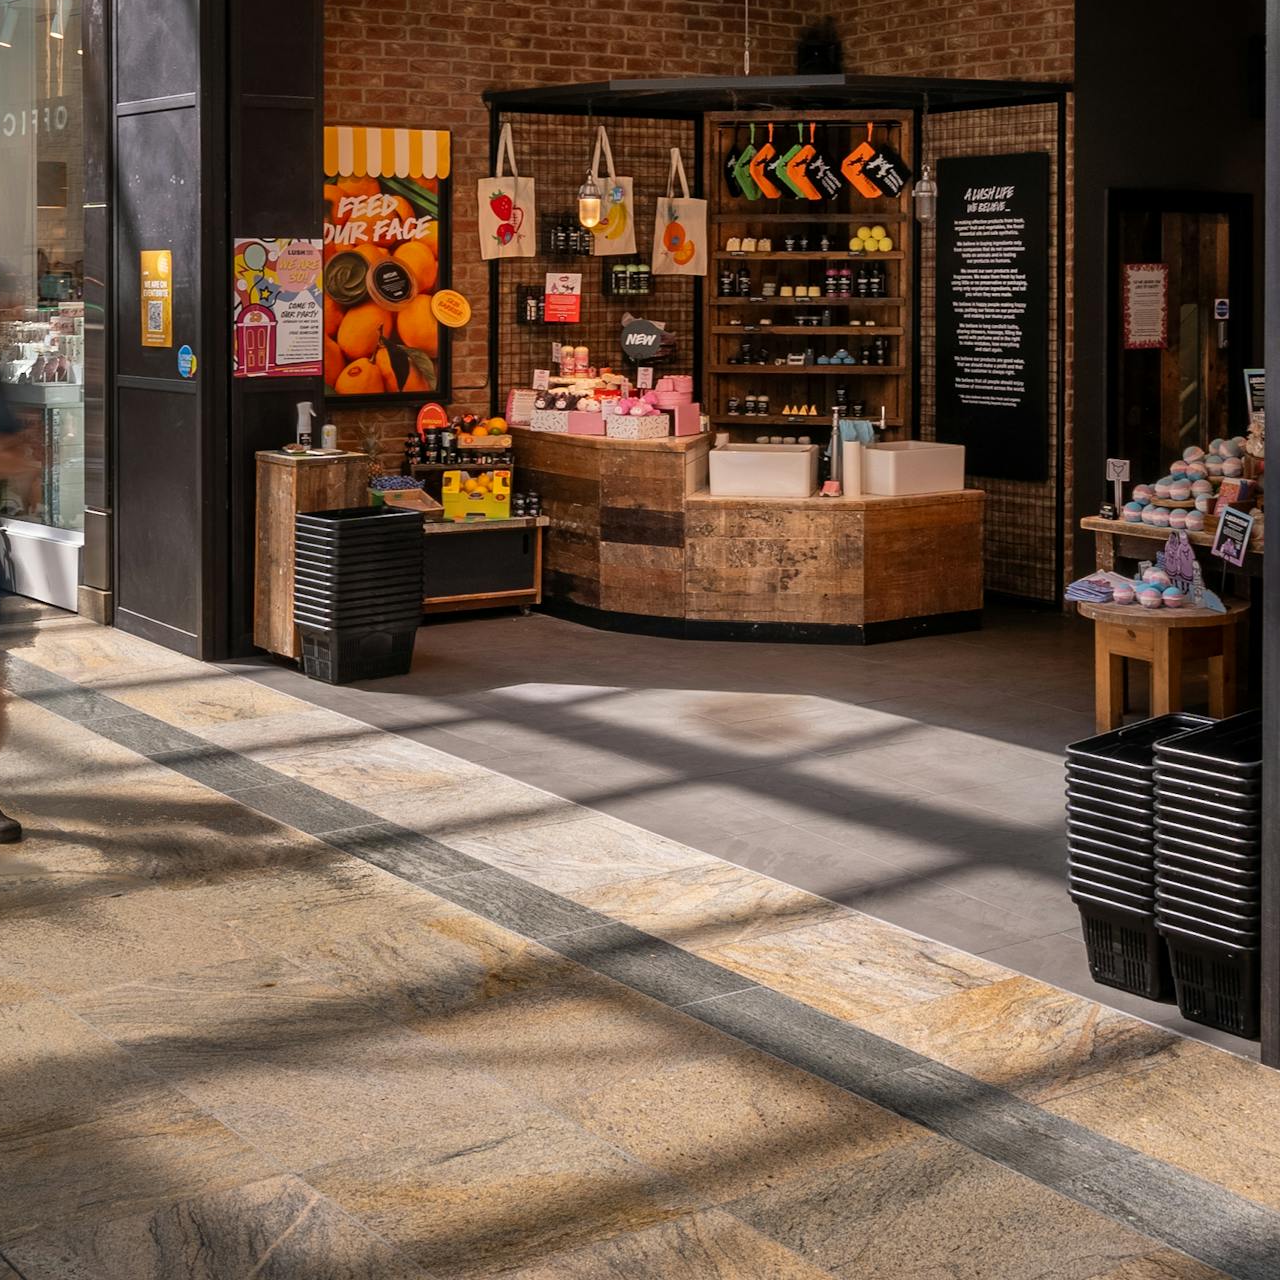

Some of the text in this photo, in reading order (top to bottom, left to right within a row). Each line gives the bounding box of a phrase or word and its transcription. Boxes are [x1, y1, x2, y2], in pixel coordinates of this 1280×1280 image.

[972, 186, 994, 200] LUSH
[995, 186, 1015, 199] LIFE
[337, 193, 400, 218] FEED
[373, 215, 433, 241] FACE
[288, 302, 316, 310] COME TO
[296, 310, 318, 318] PARTY
[626, 334, 656, 346] NEW
